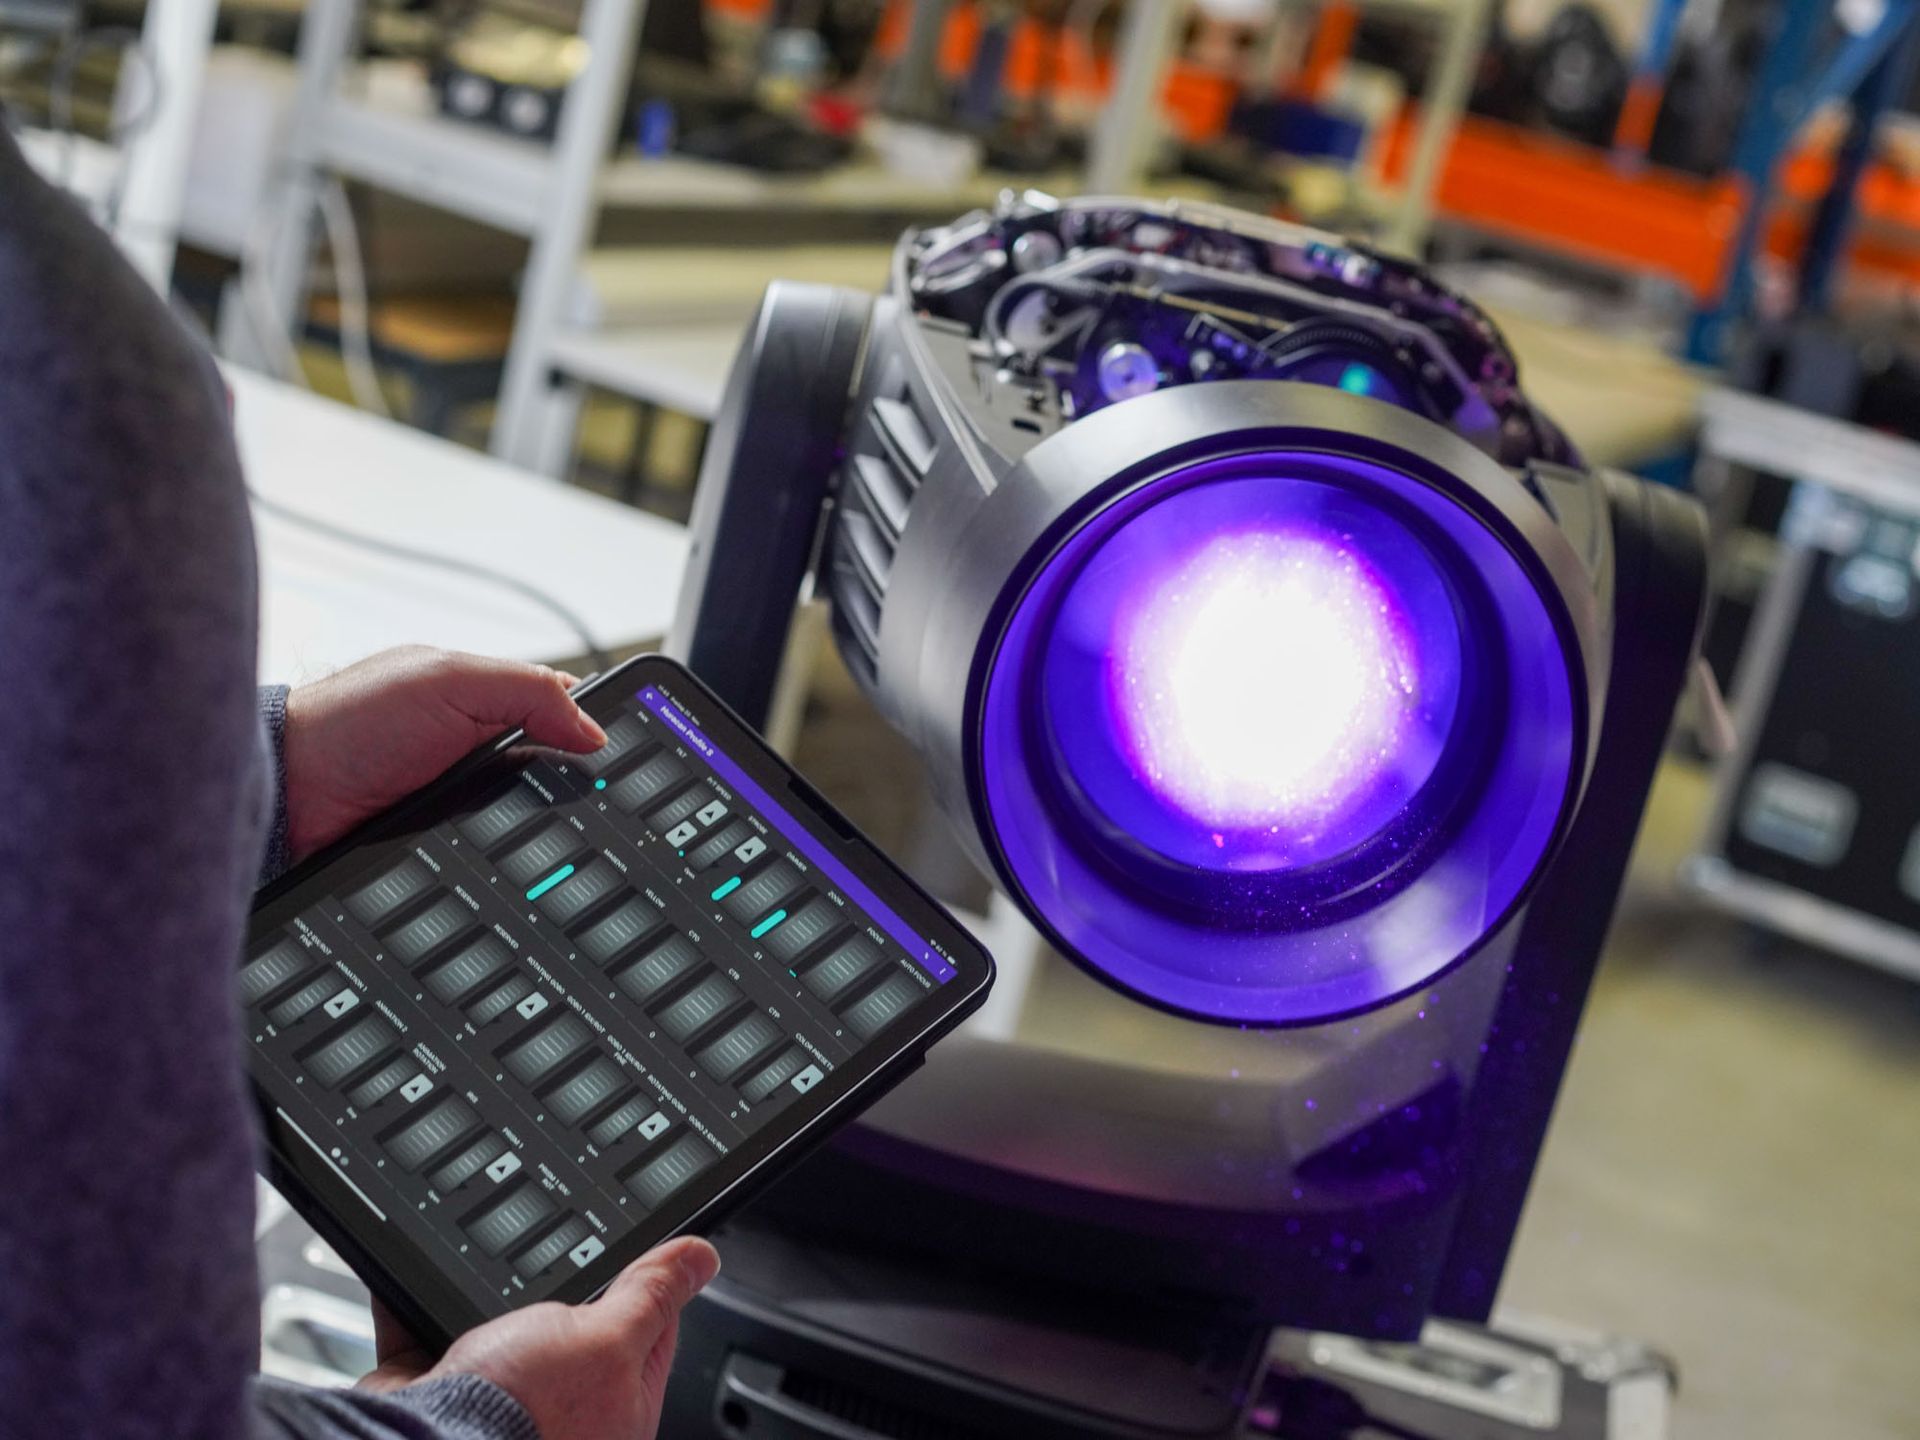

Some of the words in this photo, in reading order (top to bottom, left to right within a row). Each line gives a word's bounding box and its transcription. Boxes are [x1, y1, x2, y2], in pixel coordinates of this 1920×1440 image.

[685, 729, 708, 751] Profile
[676, 746, 687, 758] TILT
[522, 771, 542, 788] COLOR
[537, 785, 554, 803] WHEEL
[715, 784, 732, 801] SPEED
[569, 816, 585, 831] CYAN
[416, 847, 441, 872] RESERVED
[603, 848, 628, 873] MAGENTA
[454, 885, 480, 910] RESERVED
[645, 888, 666, 908] YELLOW
[827, 890, 845, 907] ZOOM
[494, 923, 519, 949] RESERVED
[688, 929, 700, 942] CTO
[866, 927, 885, 945] FOCUS
[336, 960, 364, 989] ANIMATION
[527, 956, 552, 981] ROTATING
[550, 978, 566, 995] GOBO
[900, 959, 915, 973] AUTO
[913, 970, 931, 989] FOCUS
[566, 995, 583, 1012] GOBO
[768, 1006, 781, 1018] CTP
[375, 1000, 404, 1029] ANIMATION
[607, 1035, 623, 1051] GOBO
[795, 1032, 814, 1051] COLOR
[811, 1048, 834, 1071] PRESETS
[413, 1047, 439, 1074] ROTATION
[417, 1042, 446, 1071] ANIMATION
[613, 1051, 628, 1066] FINE
[647, 1074, 673, 1101] ROTATING
[671, 1097, 687, 1114] GOBO
[688, 1115, 705, 1131] GOBO
[502, 1127, 521, 1146] PRISM
[538, 1163, 557, 1182] PRISM
[585, 1210, 604, 1229] PRISM
